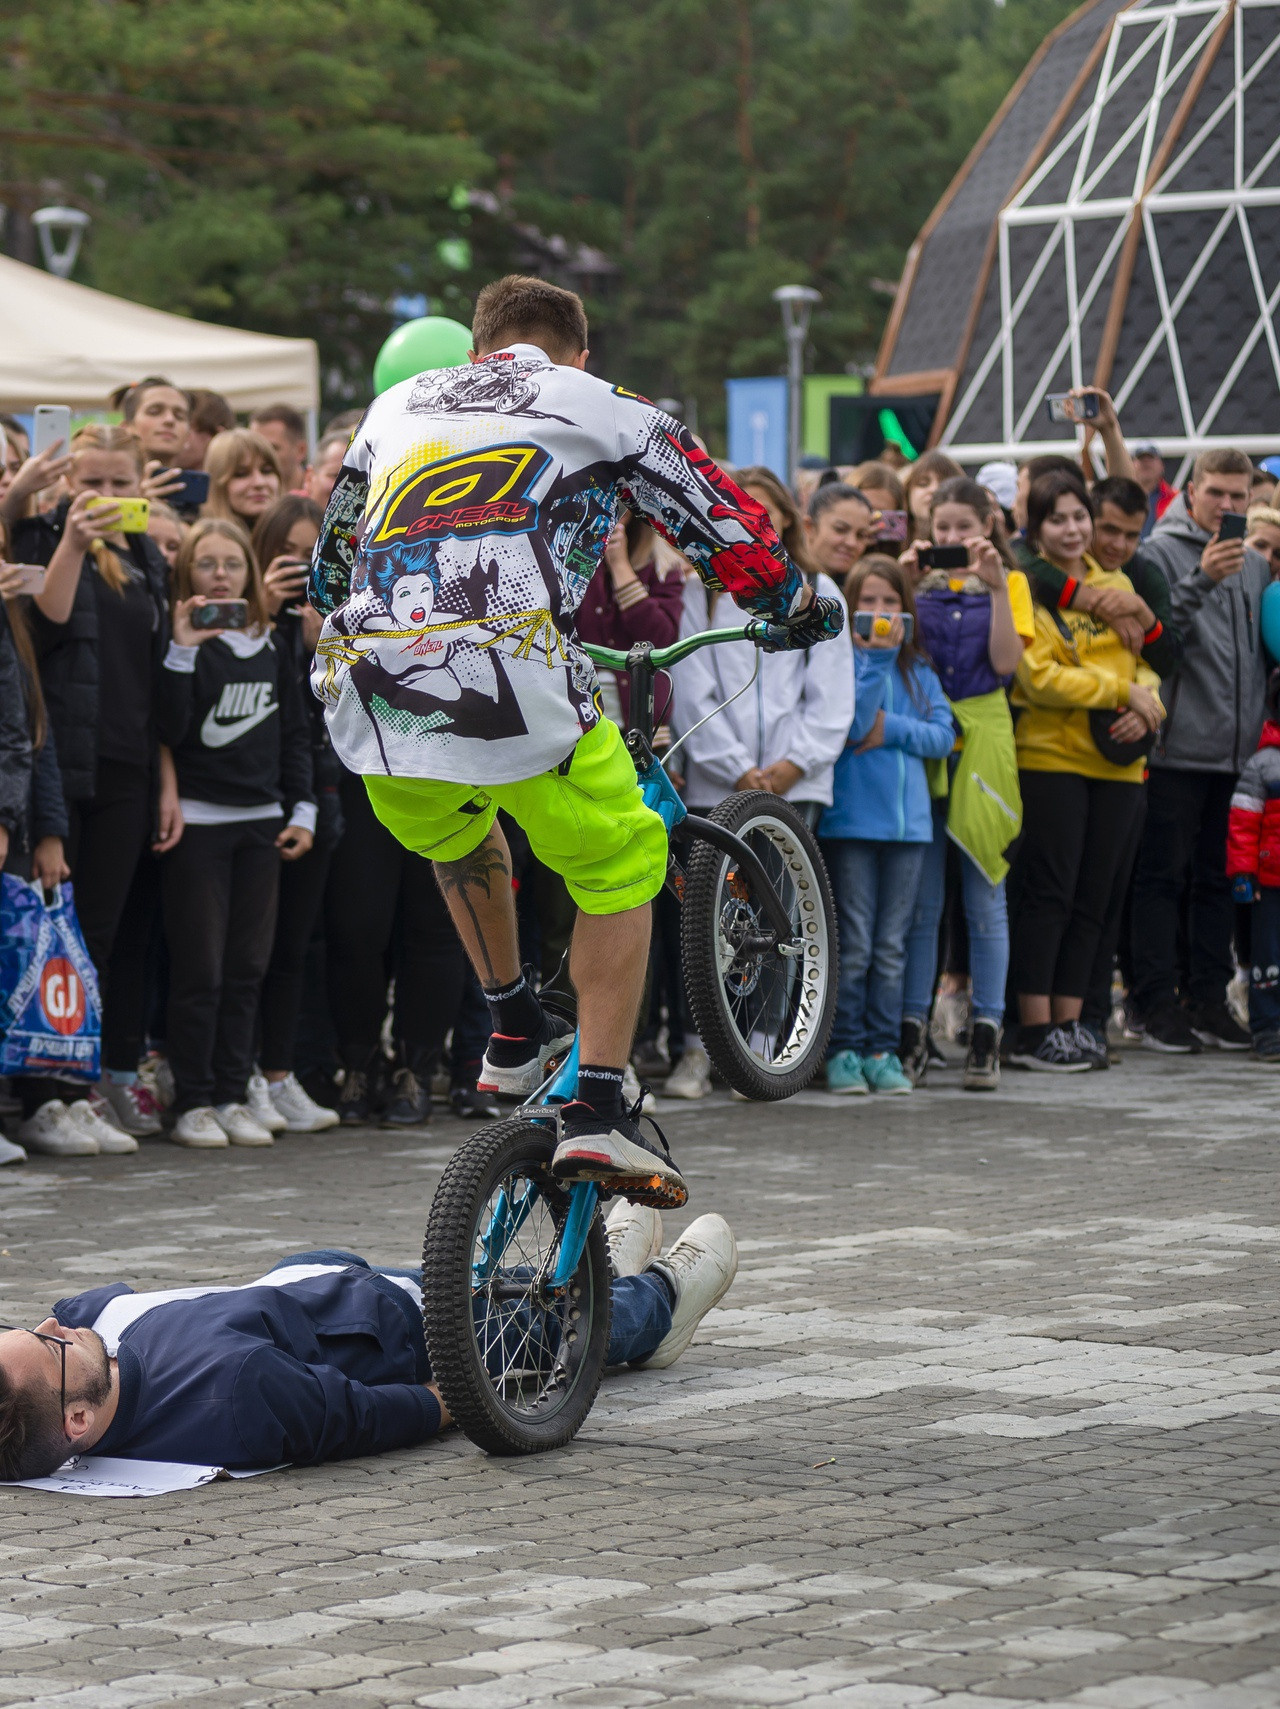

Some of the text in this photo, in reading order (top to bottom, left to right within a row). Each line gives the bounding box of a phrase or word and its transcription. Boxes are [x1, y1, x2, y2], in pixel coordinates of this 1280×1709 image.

[406, 501, 529, 536] ONEAL
[455, 515, 527, 529] MOTOCROSS
[216, 682, 273, 718] NIKE
[46, 974, 78, 1018] GJ
